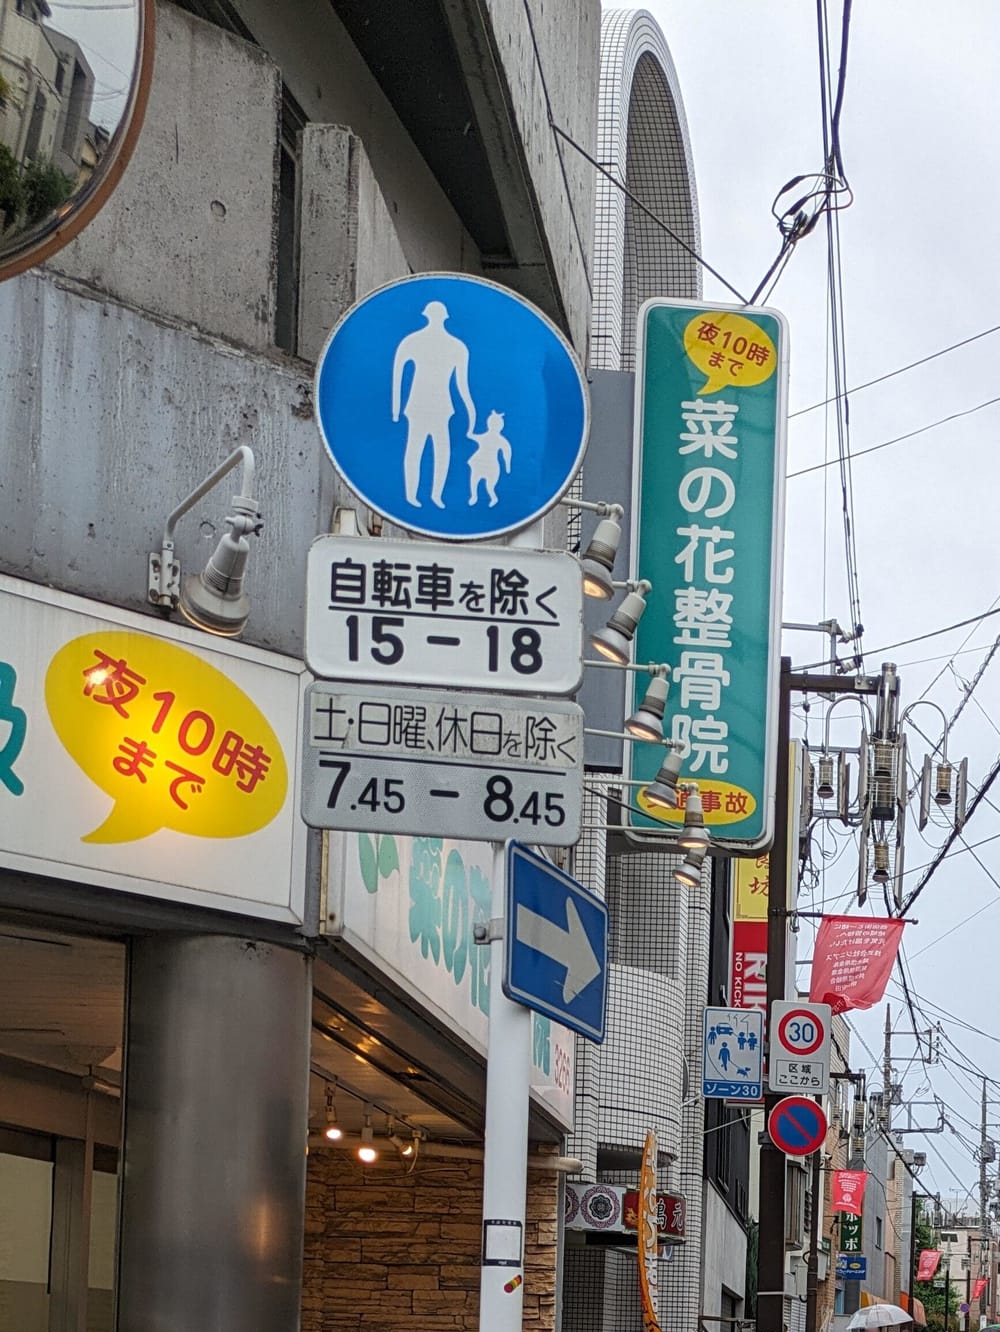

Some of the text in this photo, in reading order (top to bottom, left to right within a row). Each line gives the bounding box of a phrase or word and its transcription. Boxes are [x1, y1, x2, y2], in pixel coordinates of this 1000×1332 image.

[697, 320, 770, 367] 夜10時
[708, 350, 744, 376] まで
[330, 558, 558, 619] 自転車を除く
[673, 399, 740, 774] 菜の花整骨院
[83, 649, 272, 793] 夜10時
[113, 737, 206, 810] まで
[735, 952, 743, 972] NO
[788, 1022, 814, 1043] 30
[778, 1074, 820, 1086] ここから
[788, 1063, 811, 1074] 区域
[707, 1083, 758, 1097] ゾーン30
